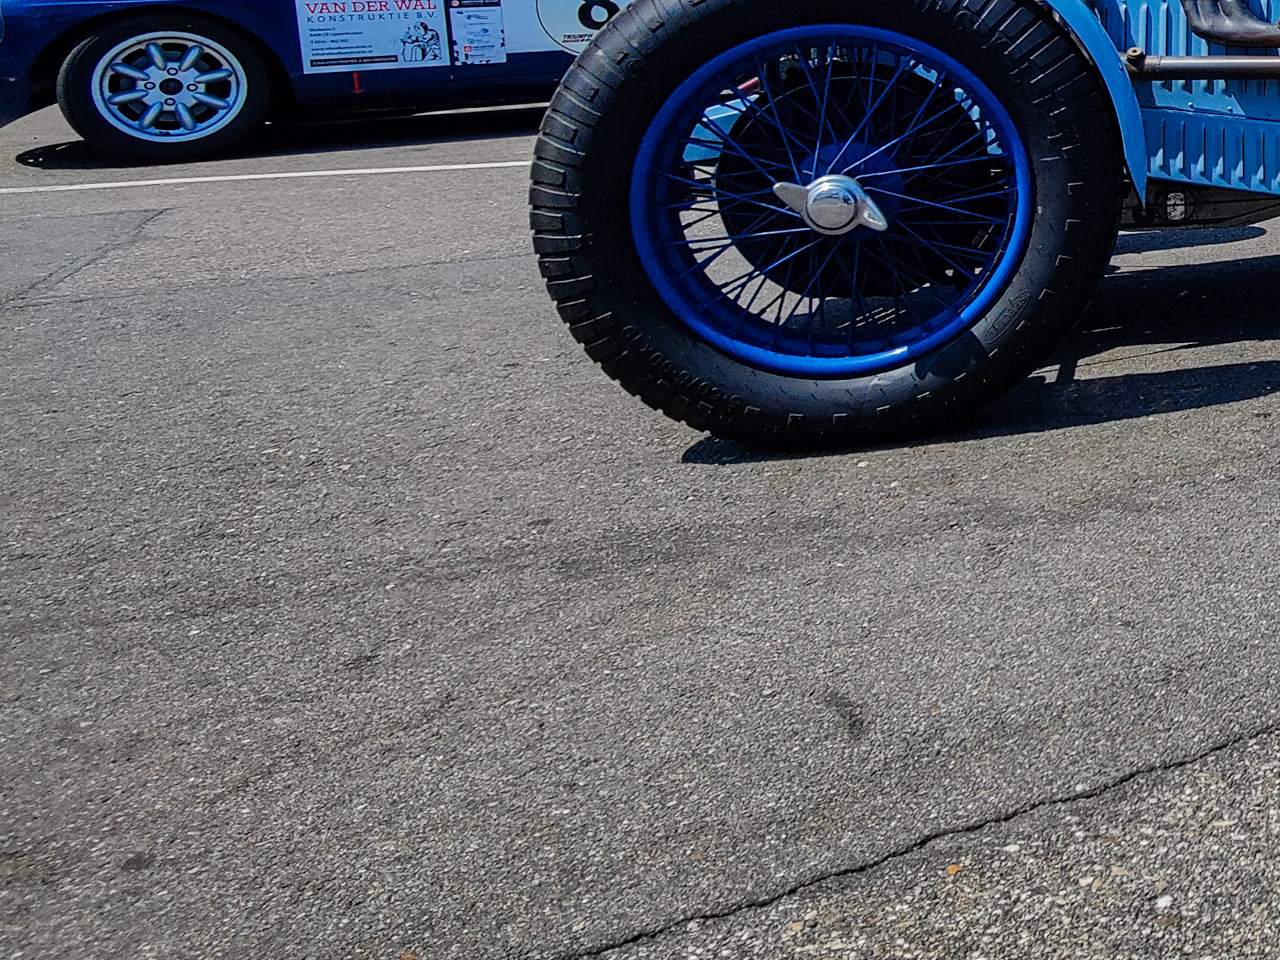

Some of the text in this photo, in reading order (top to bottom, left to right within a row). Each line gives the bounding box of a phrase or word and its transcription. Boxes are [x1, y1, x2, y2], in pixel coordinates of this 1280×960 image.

[304, 1, 346, 14] VAN
[352, 0, 390, 13] DER
[306, 11, 438, 24] KONSTRUKTIE B.V.
